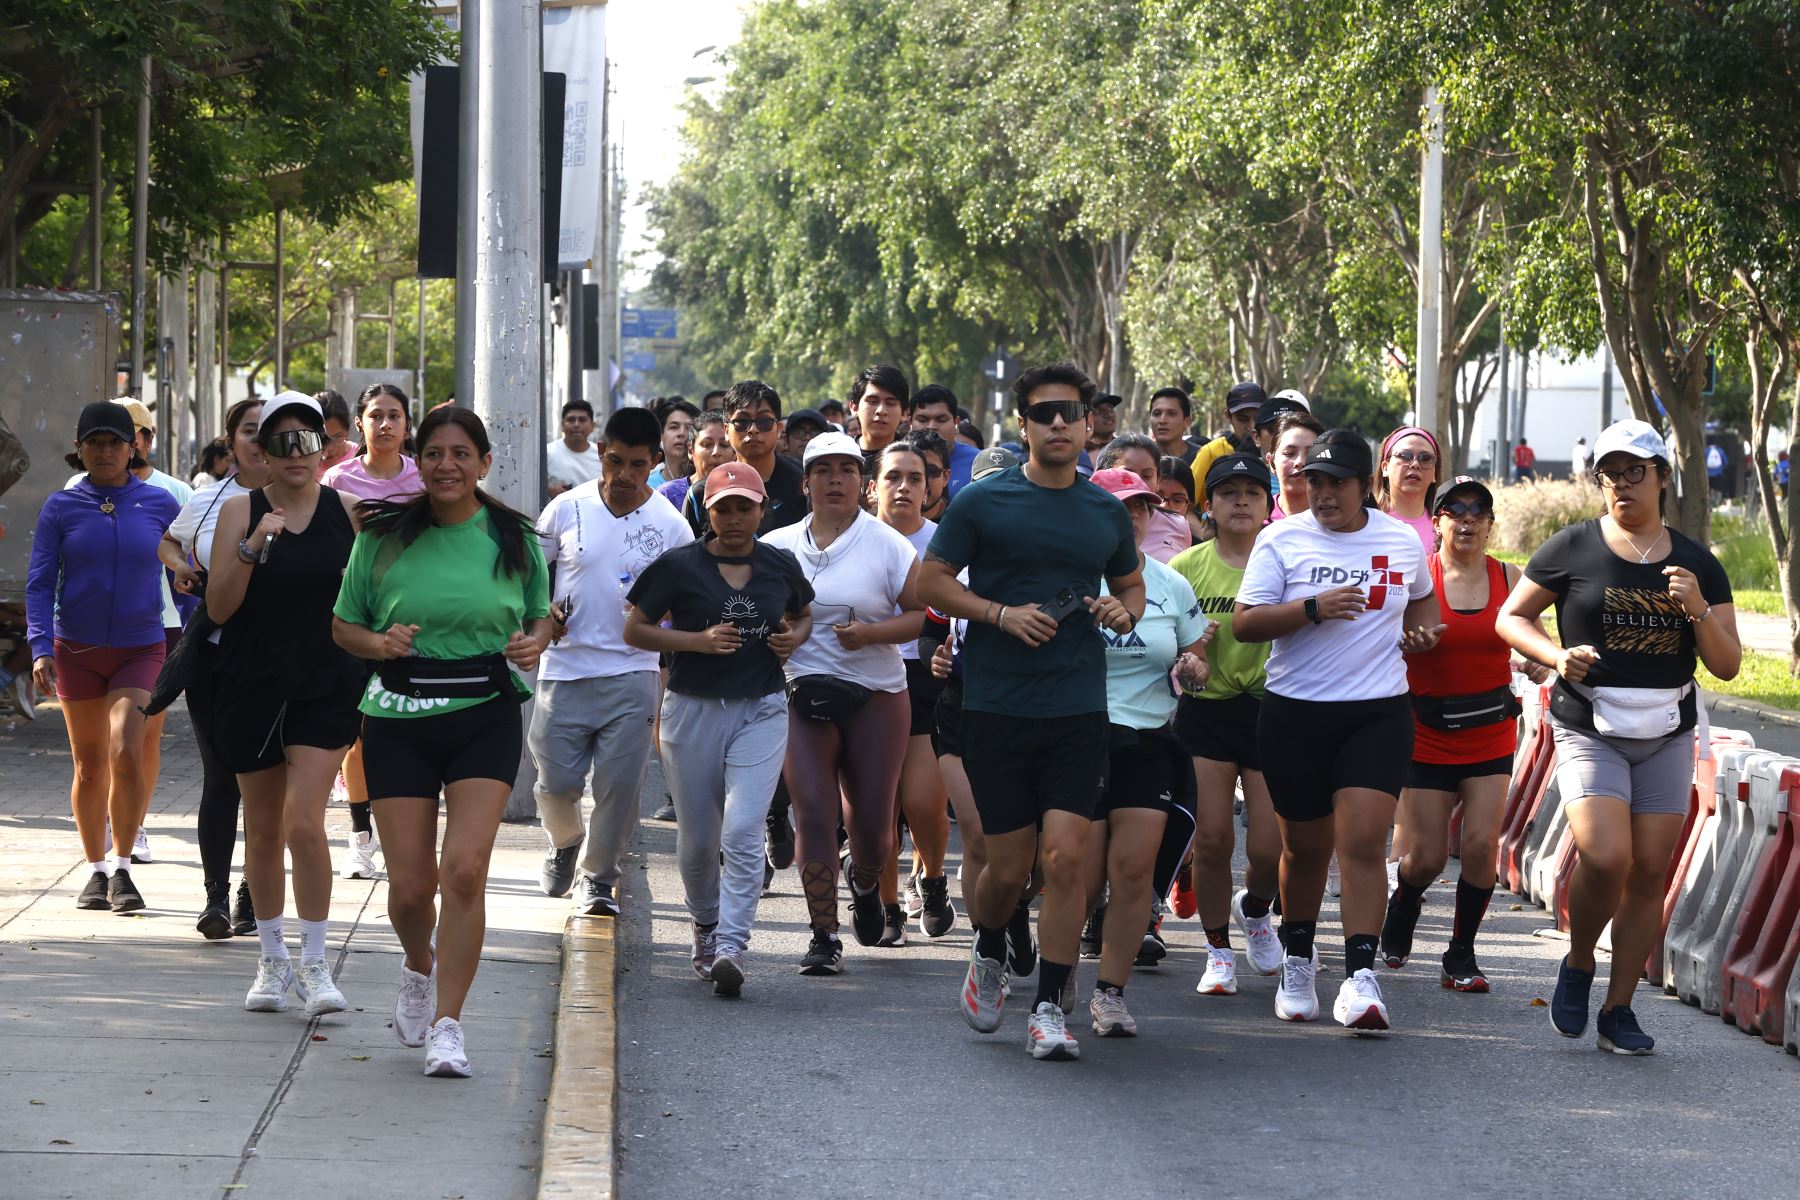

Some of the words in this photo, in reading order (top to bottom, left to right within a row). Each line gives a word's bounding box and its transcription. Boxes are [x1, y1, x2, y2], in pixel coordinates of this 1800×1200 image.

[1310, 567, 1348, 584] IPD
[1388, 586, 1404, 595] 2025
[1603, 614, 1683, 628] BELIEVE
